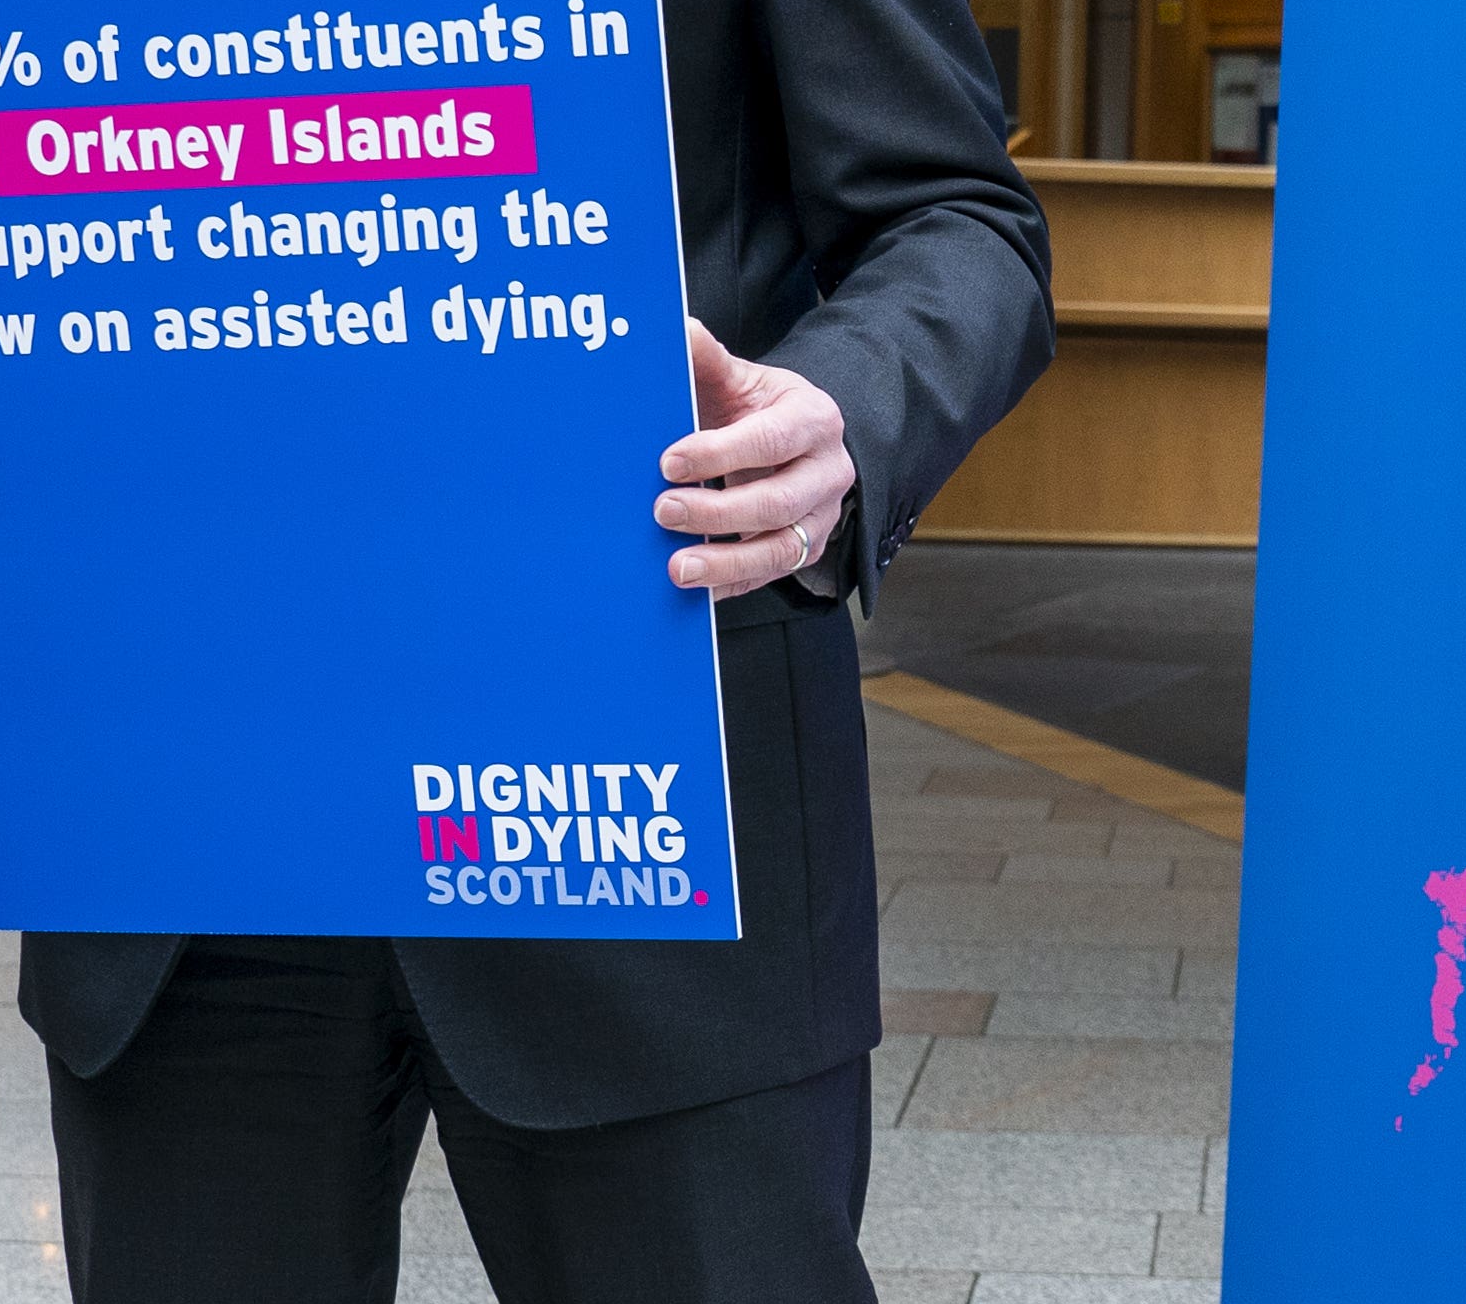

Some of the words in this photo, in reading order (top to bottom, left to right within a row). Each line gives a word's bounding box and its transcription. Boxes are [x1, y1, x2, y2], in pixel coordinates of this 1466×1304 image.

[64, 24, 119, 83] of
[144, 1, 544, 79] constituents
[27, 120, 244, 181] Orkney
[269, 99, 495, 165] Islands
[197, 193, 477, 268] changing
[501, 188, 608, 247] the
[60, 311, 130, 354] on
[154, 286, 407, 350] assisted
[432, 281, 629, 354] dying.
[413, 764, 679, 812] DIGNITY
[419, 816, 480, 862] IN
[492, 816, 685, 863] DYING
